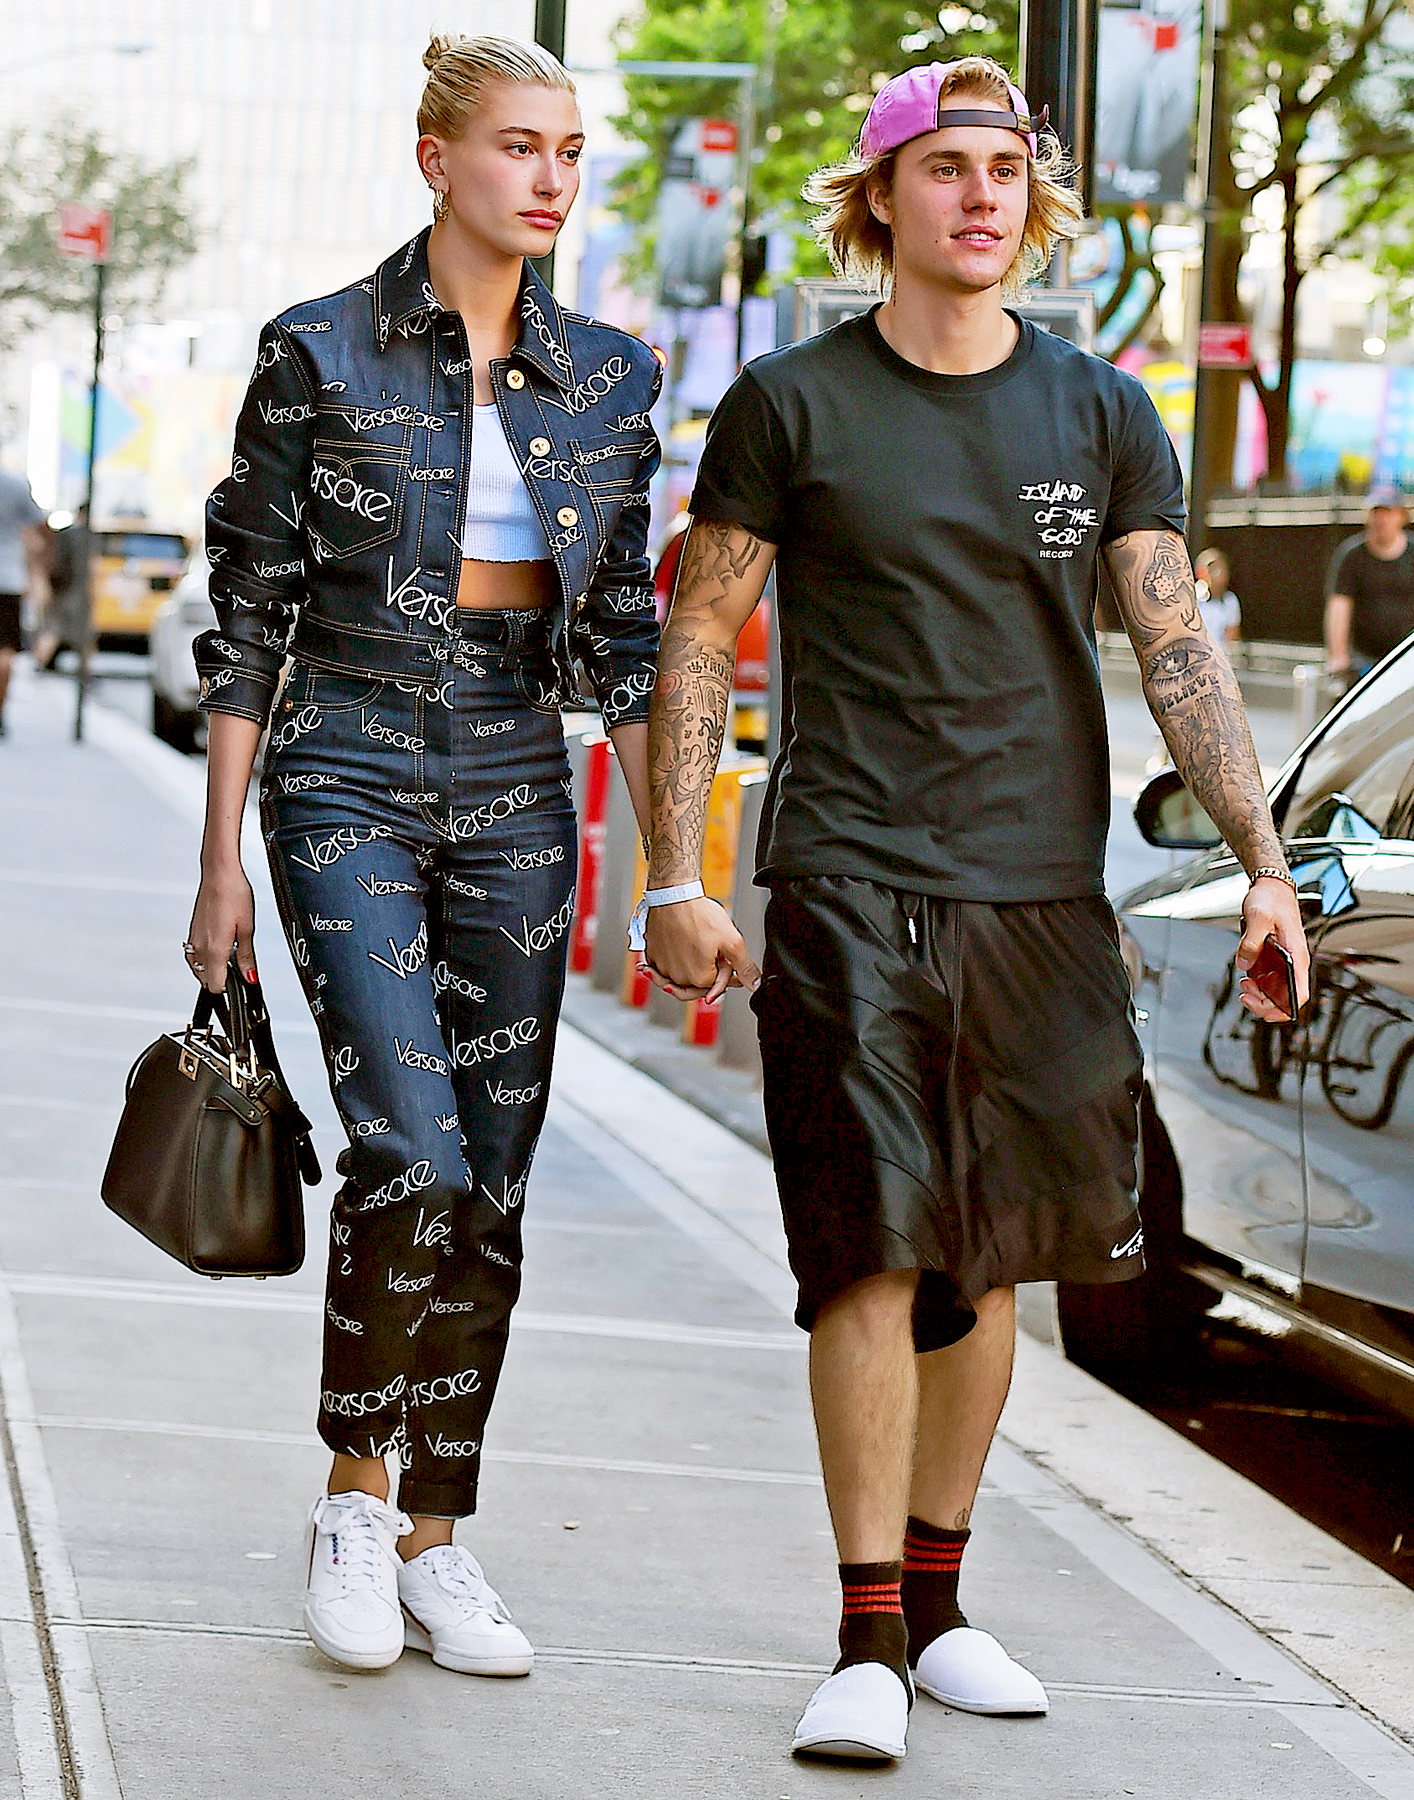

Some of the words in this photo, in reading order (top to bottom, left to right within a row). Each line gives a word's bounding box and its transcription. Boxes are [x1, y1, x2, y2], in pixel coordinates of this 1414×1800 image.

[281, 320, 332, 334] Versace
[537, 356, 632, 417] Versace
[341, 403, 412, 434] Versace
[407, 463, 454, 482] Versace
[1018, 479, 1087, 505] ISLAND
[1034, 506, 1063, 525] OF
[1066, 507, 1100, 527] THE
[1037, 527, 1088, 546] GODS
[252, 558, 302, 580] Versace
[360, 707, 426, 754] Versace
[467, 718, 517, 738] Versace
[388, 787, 440, 804] Versace
[498, 845, 565, 872] Versace
[308, 912, 354, 931] Versace
[446, 1017, 541, 1071] Versace
[428, 1296, 475, 1314] Versace
